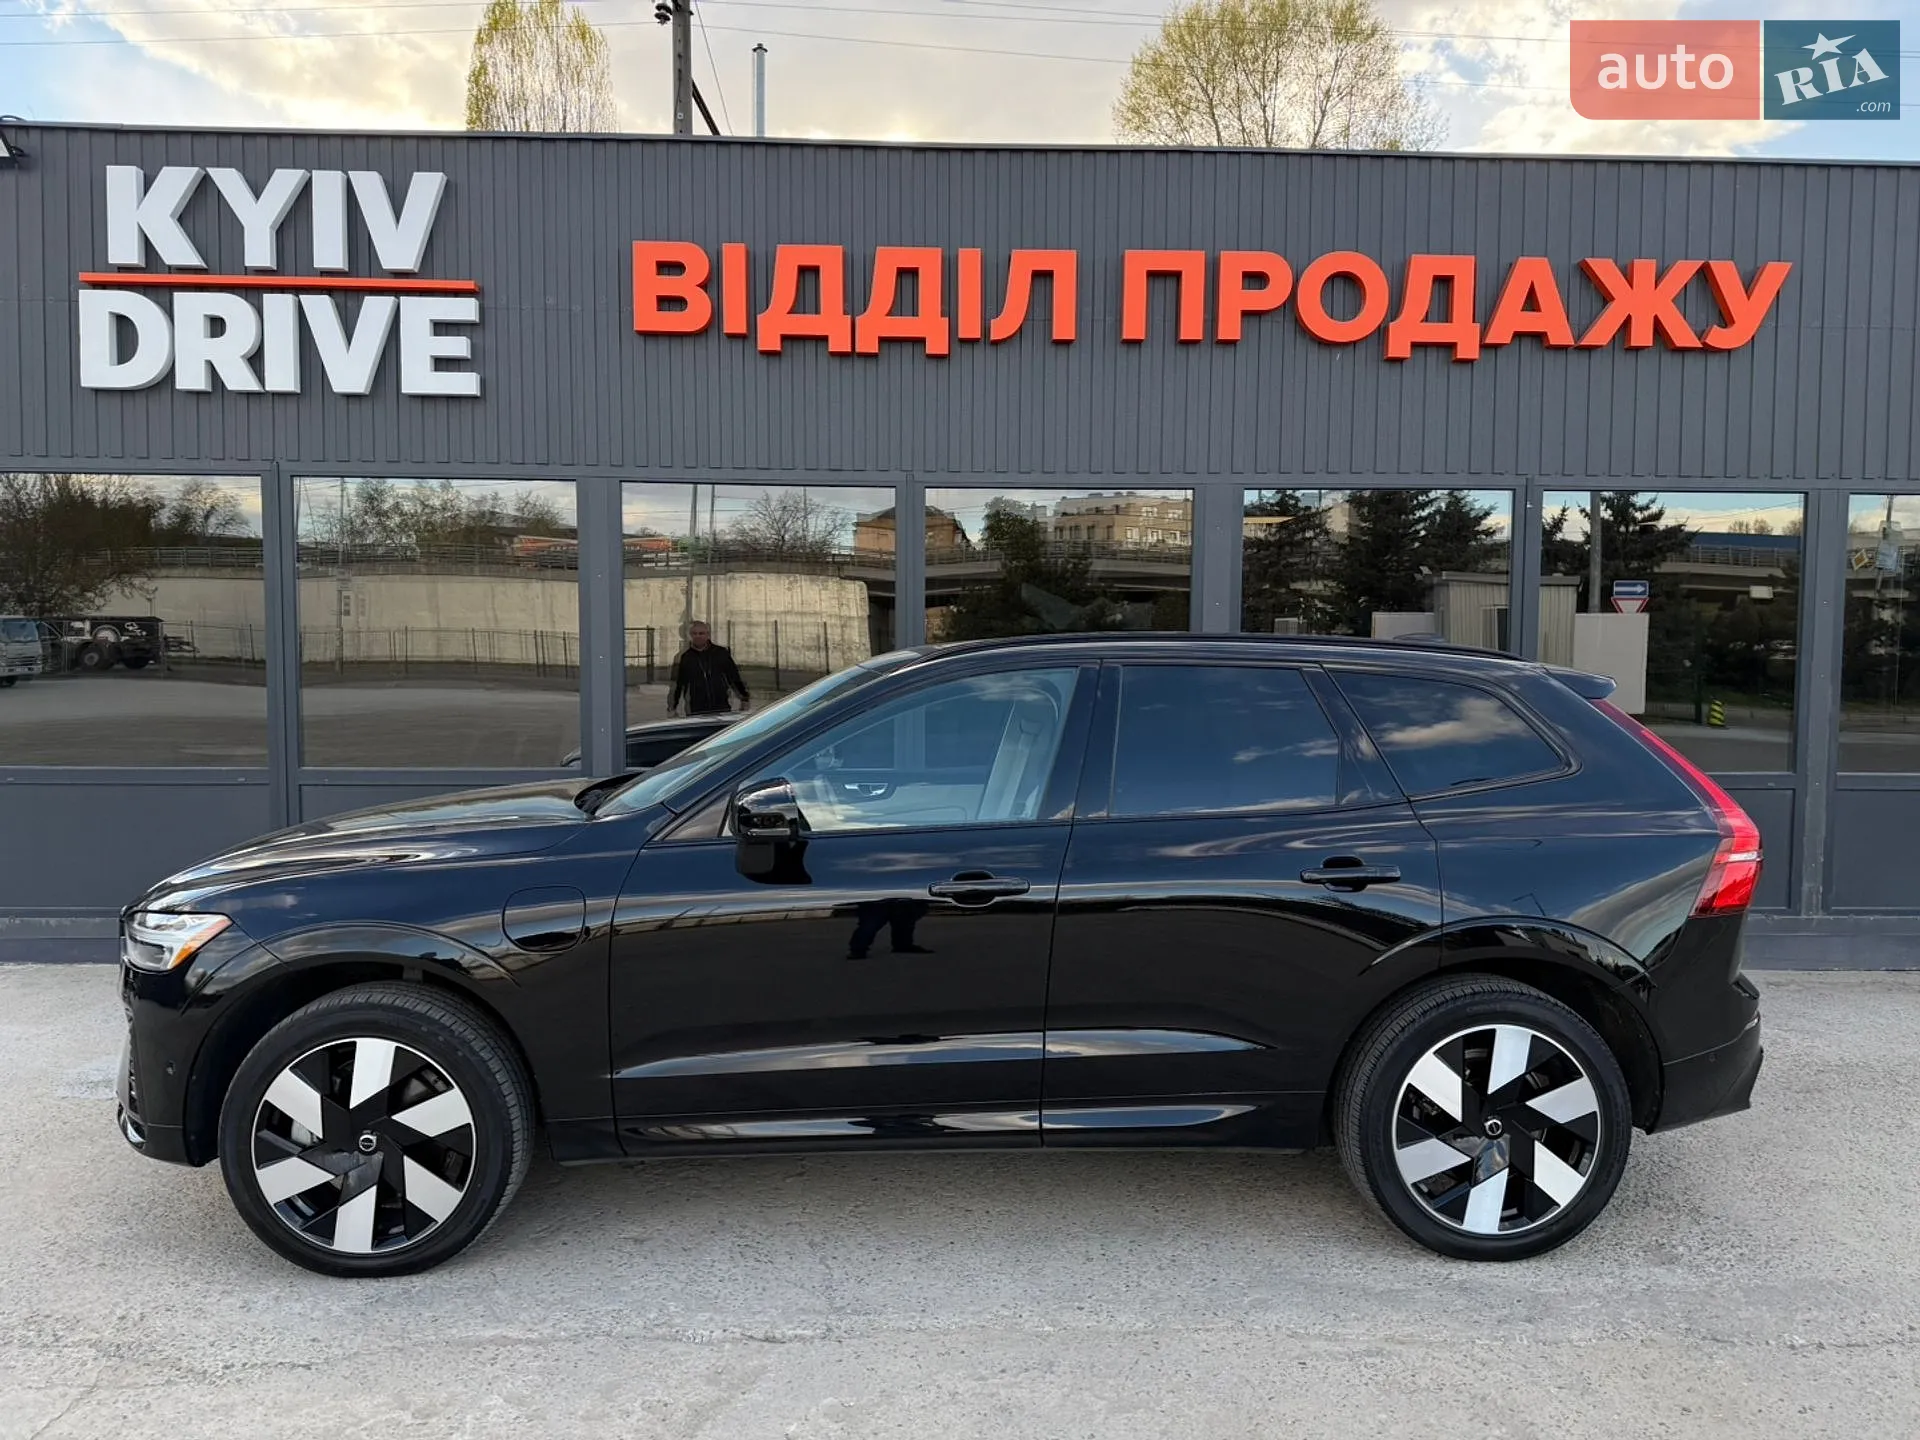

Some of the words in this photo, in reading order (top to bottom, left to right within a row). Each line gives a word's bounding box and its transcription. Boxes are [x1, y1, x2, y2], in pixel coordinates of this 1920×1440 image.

[106, 165, 447, 273] KYIV
[79, 289, 481, 396] DRIVE
[632, 240, 1077, 357] ВІДДІЛ
[1120, 249, 1793, 363] ПРОДАЖУ
